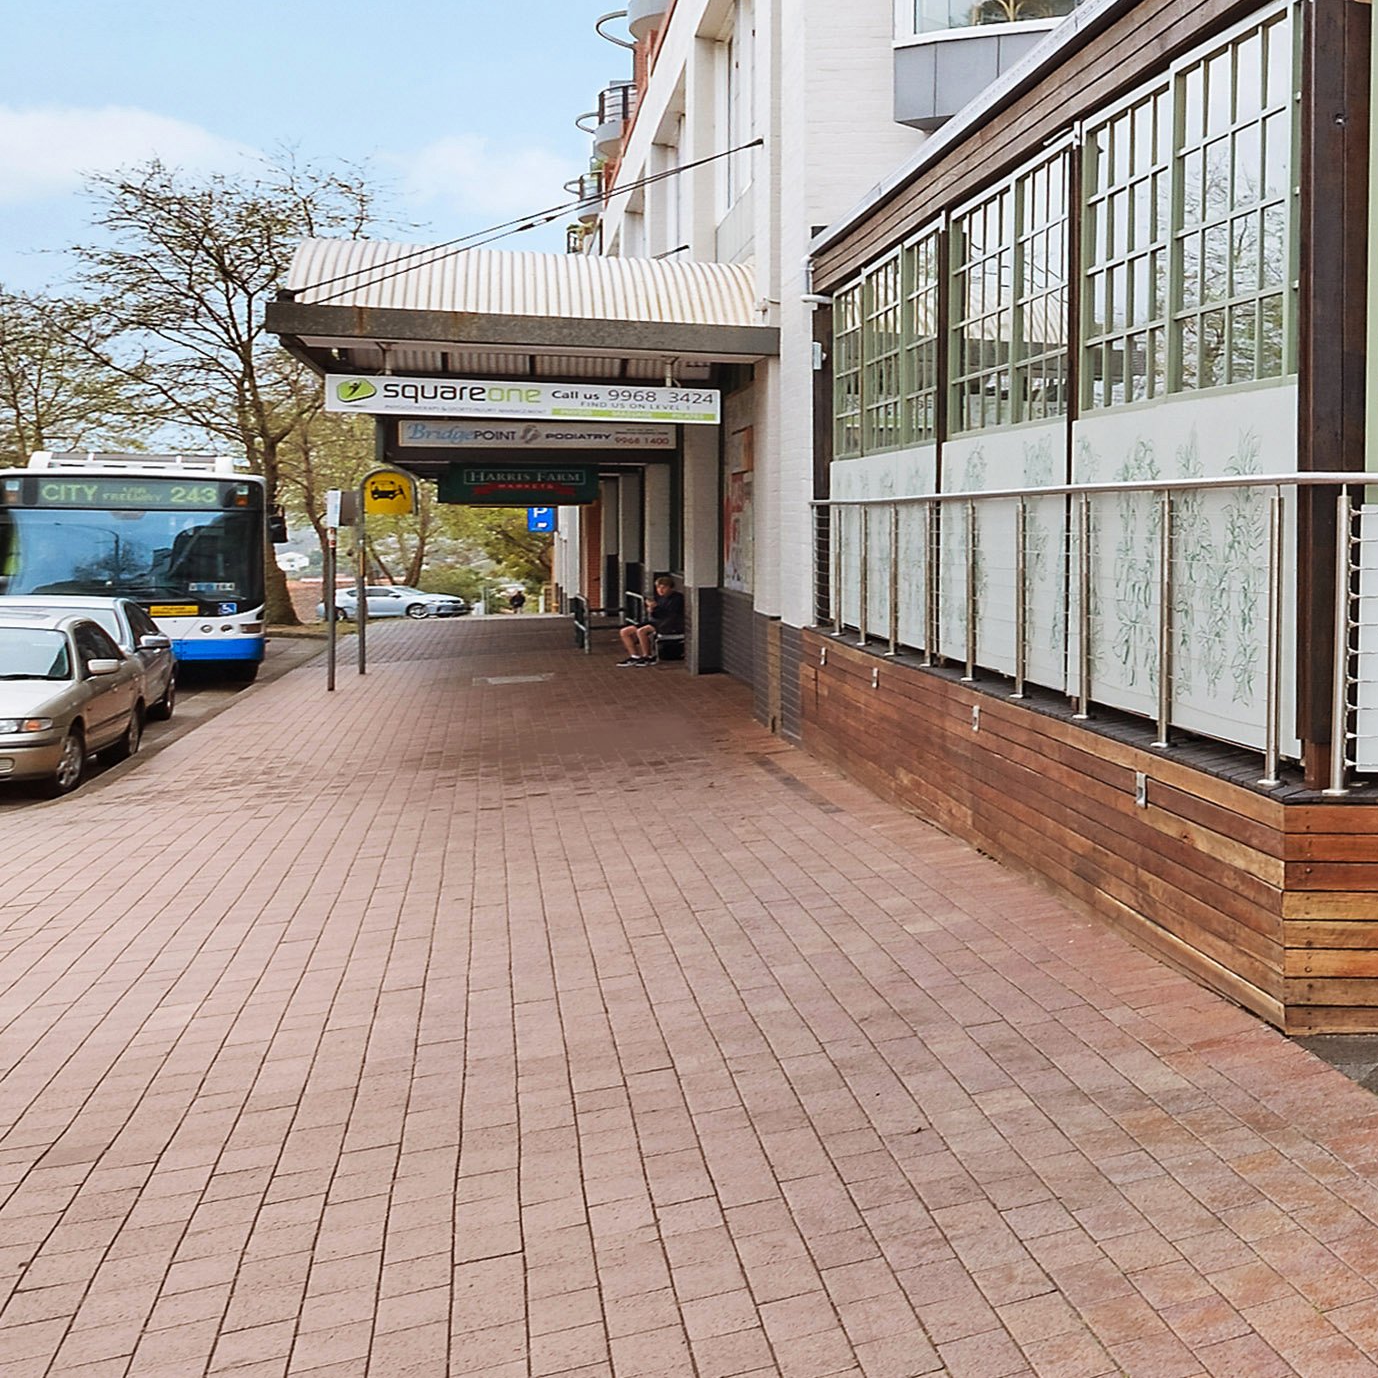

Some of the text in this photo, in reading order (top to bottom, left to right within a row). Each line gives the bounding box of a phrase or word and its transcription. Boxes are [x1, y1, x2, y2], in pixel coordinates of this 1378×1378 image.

[552, 390, 579, 399] Call
[584, 391, 600, 400] us
[608, 389, 657, 402] 9968
[669, 392, 713, 404] 3424
[470, 472, 580, 482] HARRIS FARM
[42, 484, 97, 502] CITY
[170, 486, 217, 503] 243
